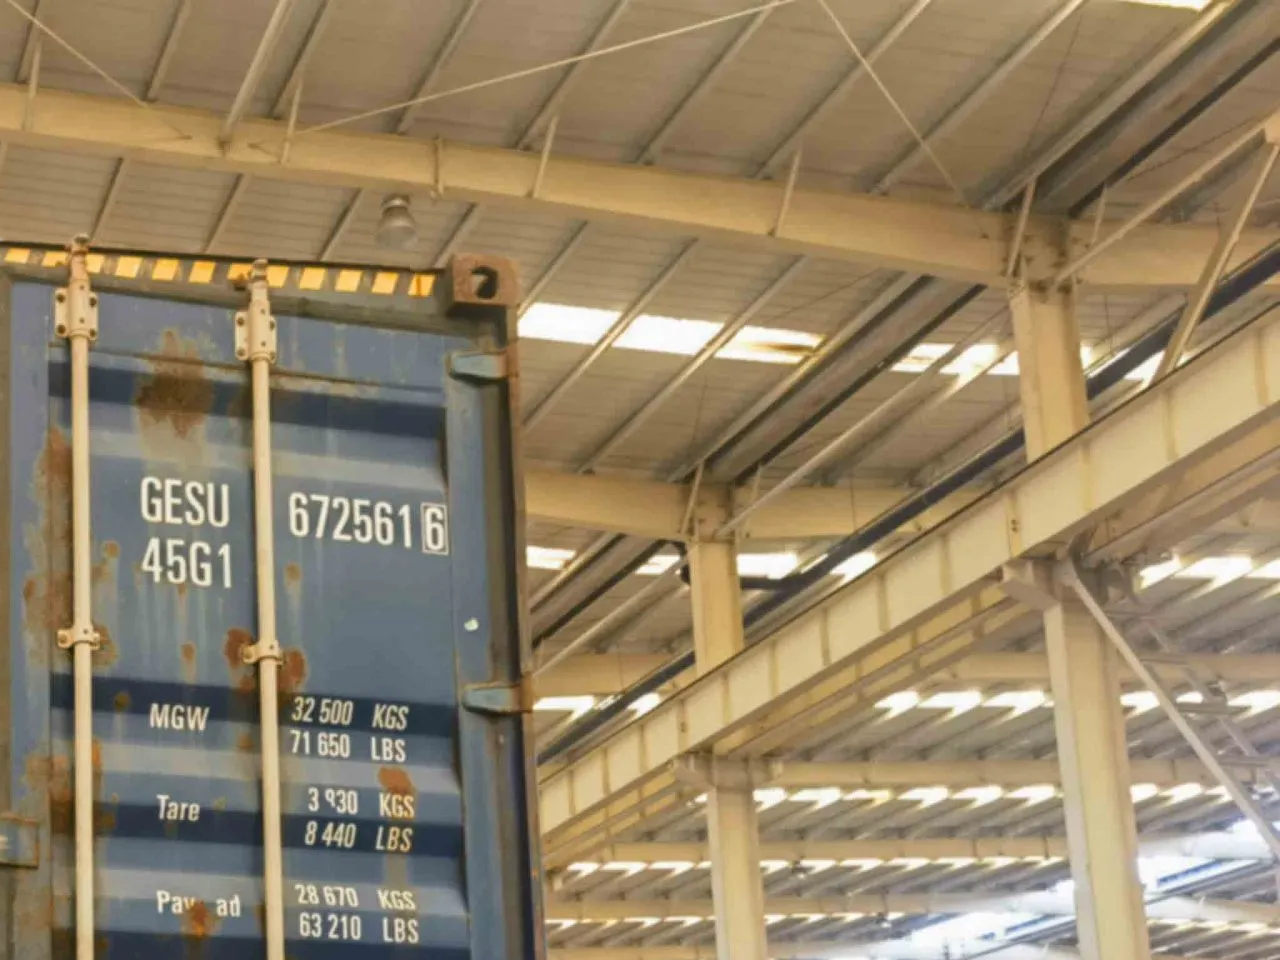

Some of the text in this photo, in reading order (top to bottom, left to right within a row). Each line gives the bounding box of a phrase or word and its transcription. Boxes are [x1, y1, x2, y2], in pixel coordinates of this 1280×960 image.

[140, 476, 446, 551] GESU 672561 6
[141, 537, 231, 589] 45G1
[149, 696, 410, 731] MGW 32 500 KGS
[290, 730, 406, 763] 71 650 LBS
[156, 794, 200, 822] Tare
[308, 787, 320, 813] 3
[379, 793, 415, 819] KGS
[304, 820, 414, 853] 8 440 LBS
[294, 883, 319, 906] 28
[324, 886, 359, 909] 670
[377, 889, 417, 911] KGS
[299, 913, 419, 944] 63 210 LBS
